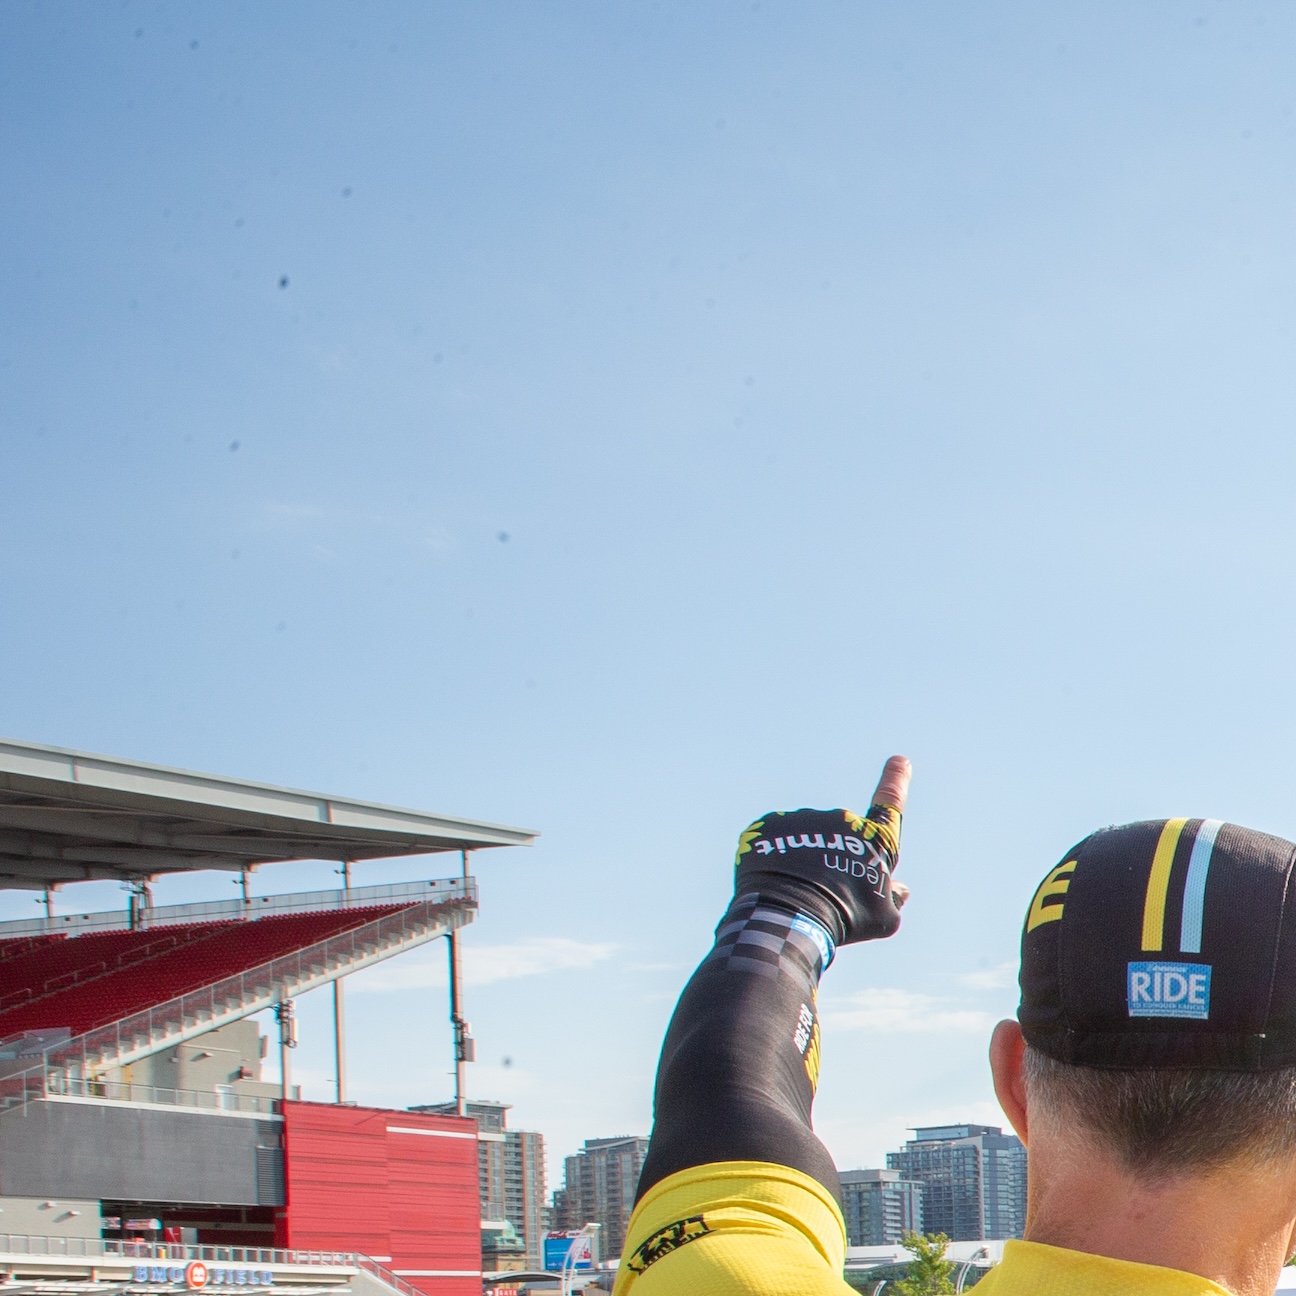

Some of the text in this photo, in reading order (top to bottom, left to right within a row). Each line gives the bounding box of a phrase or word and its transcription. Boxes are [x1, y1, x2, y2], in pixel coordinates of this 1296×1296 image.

[755, 833, 888, 872] Kermit
[824, 854, 888, 898] Team
[1131, 972, 1206, 1004] RIDE
[133, 1266, 274, 1285] BMO FIELD
